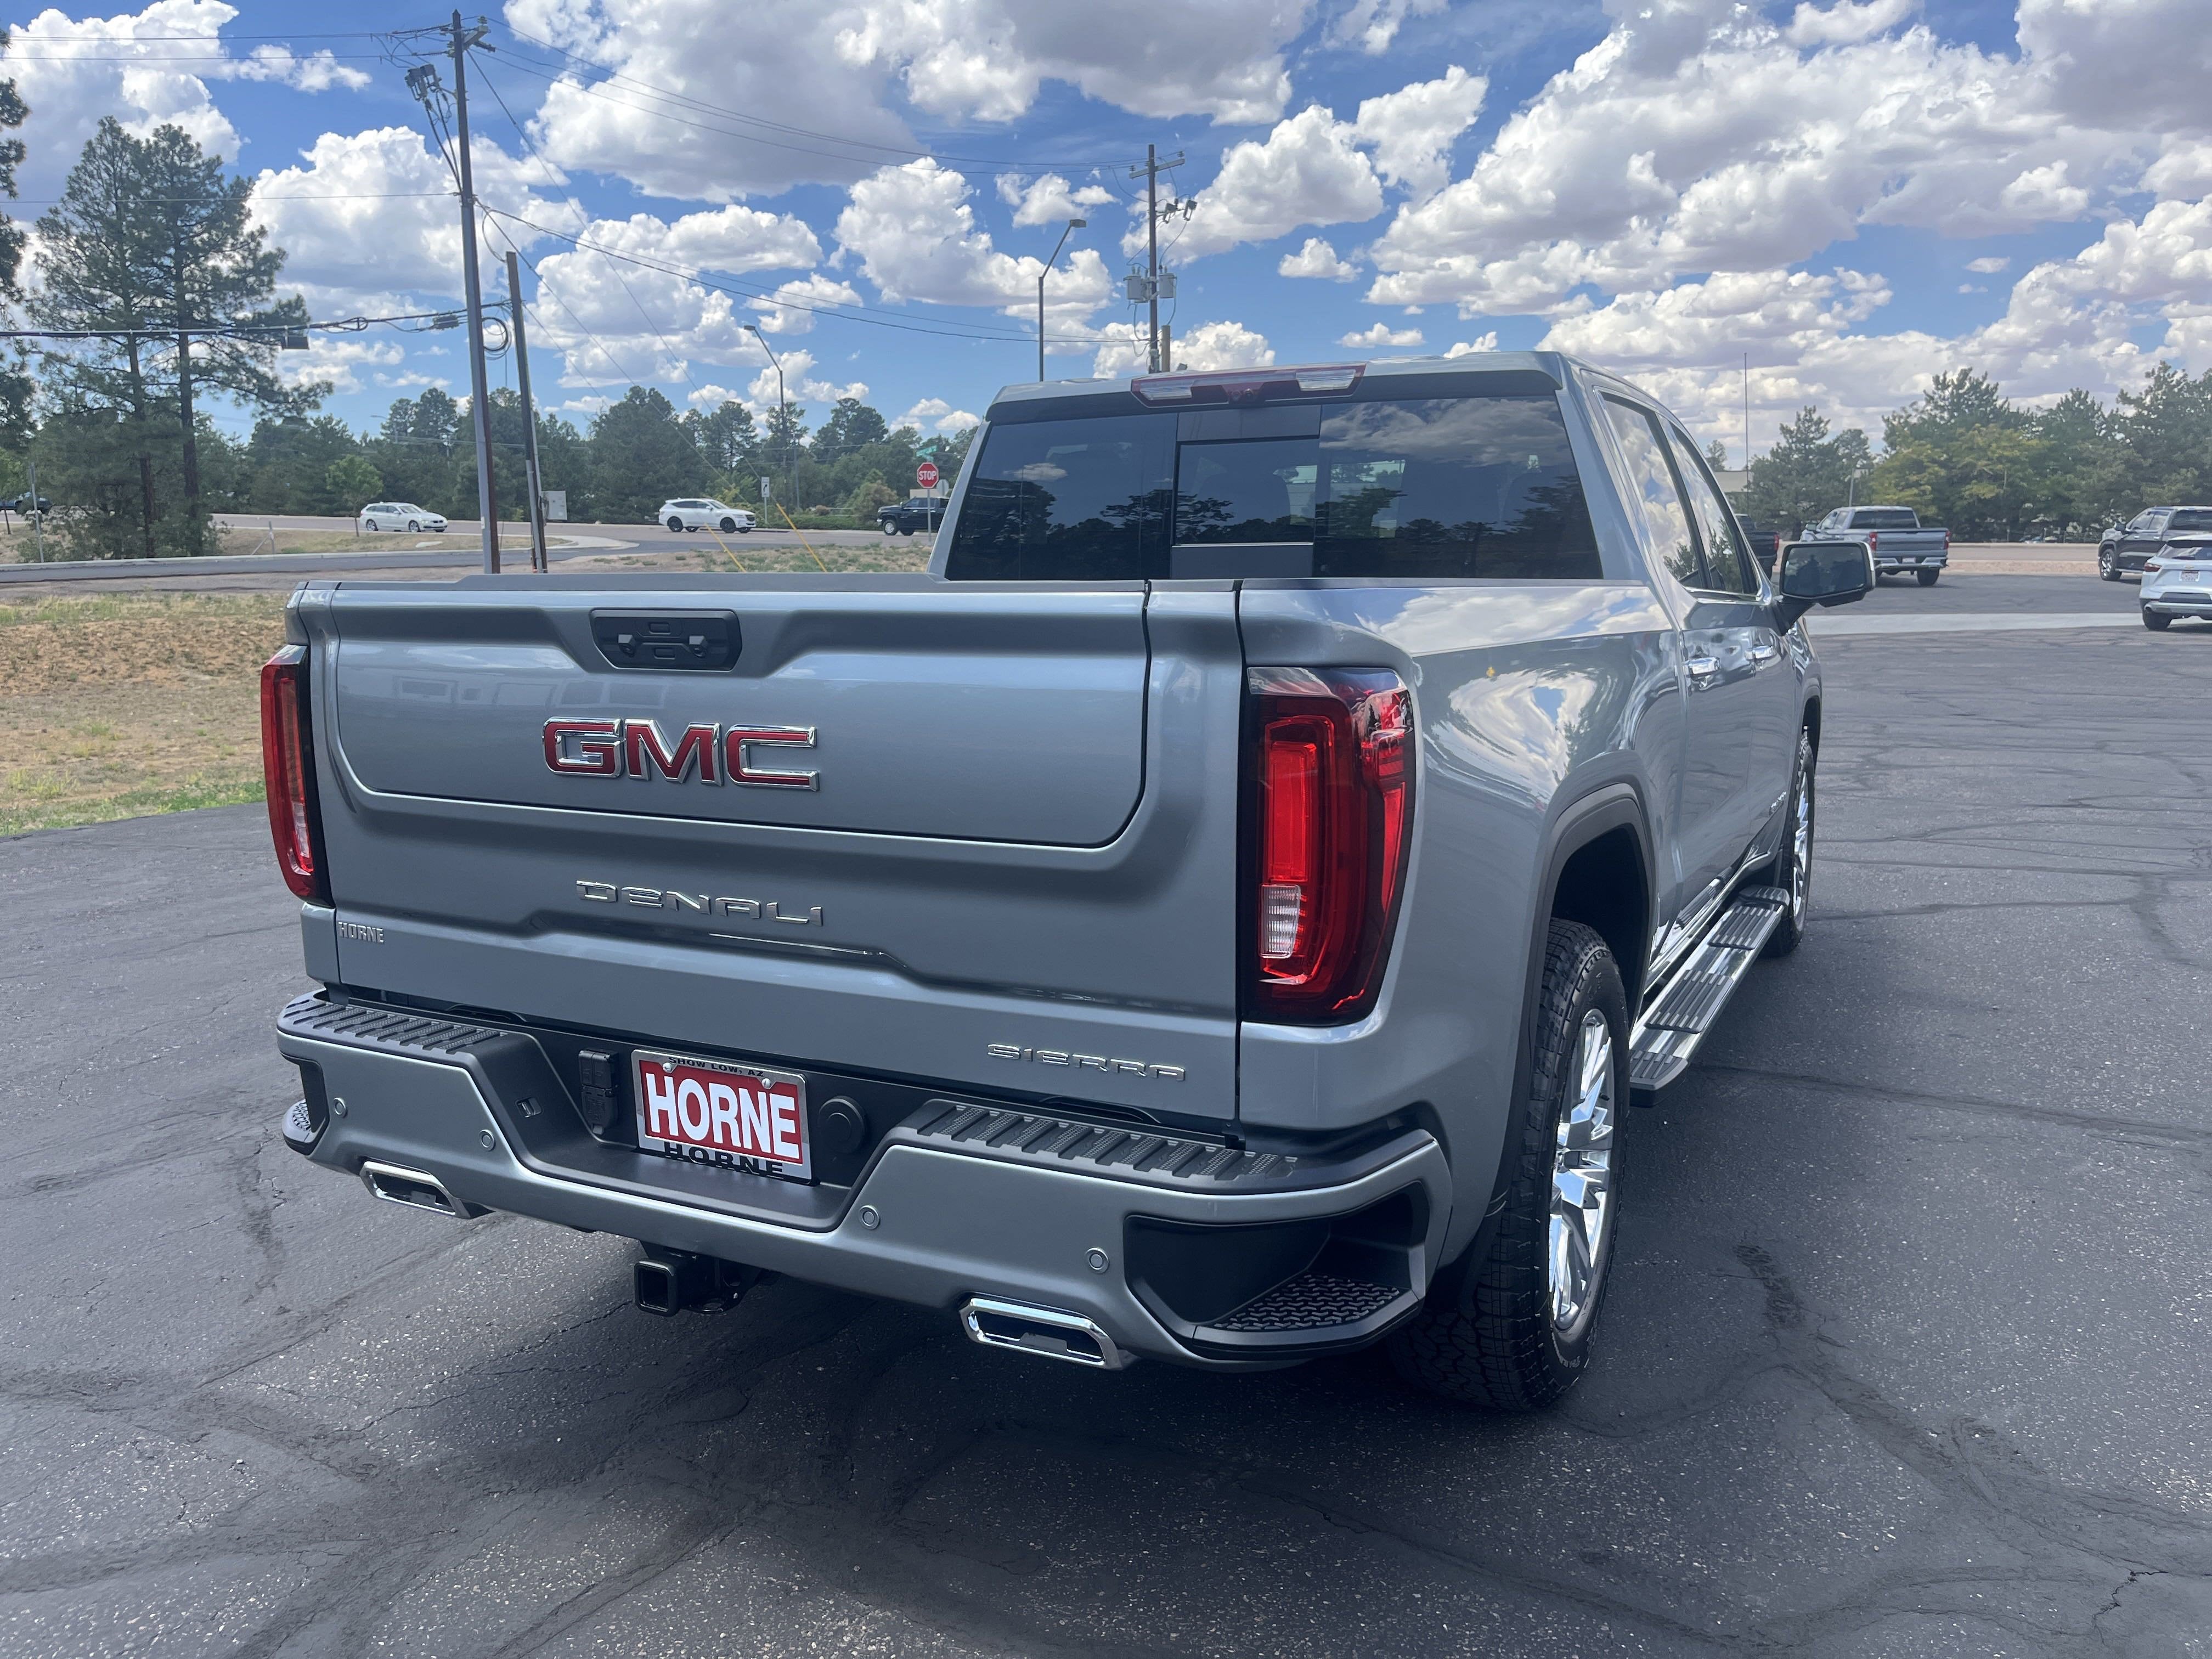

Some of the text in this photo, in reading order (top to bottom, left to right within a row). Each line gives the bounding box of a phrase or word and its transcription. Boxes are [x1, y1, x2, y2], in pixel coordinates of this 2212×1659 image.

[918, 471, 936, 480] STOP
[542, 716, 820, 791] GMC
[575, 879, 823, 926] DENALI
[338, 922, 385, 943] HORNE
[668, 1057, 706, 1068] SHOW
[711, 1064, 742, 1074] LOW,
[988, 1043, 1186, 1081] SIERRA
[646, 1073, 799, 1159] HORNE
[664, 1141, 785, 1179] HORNE
